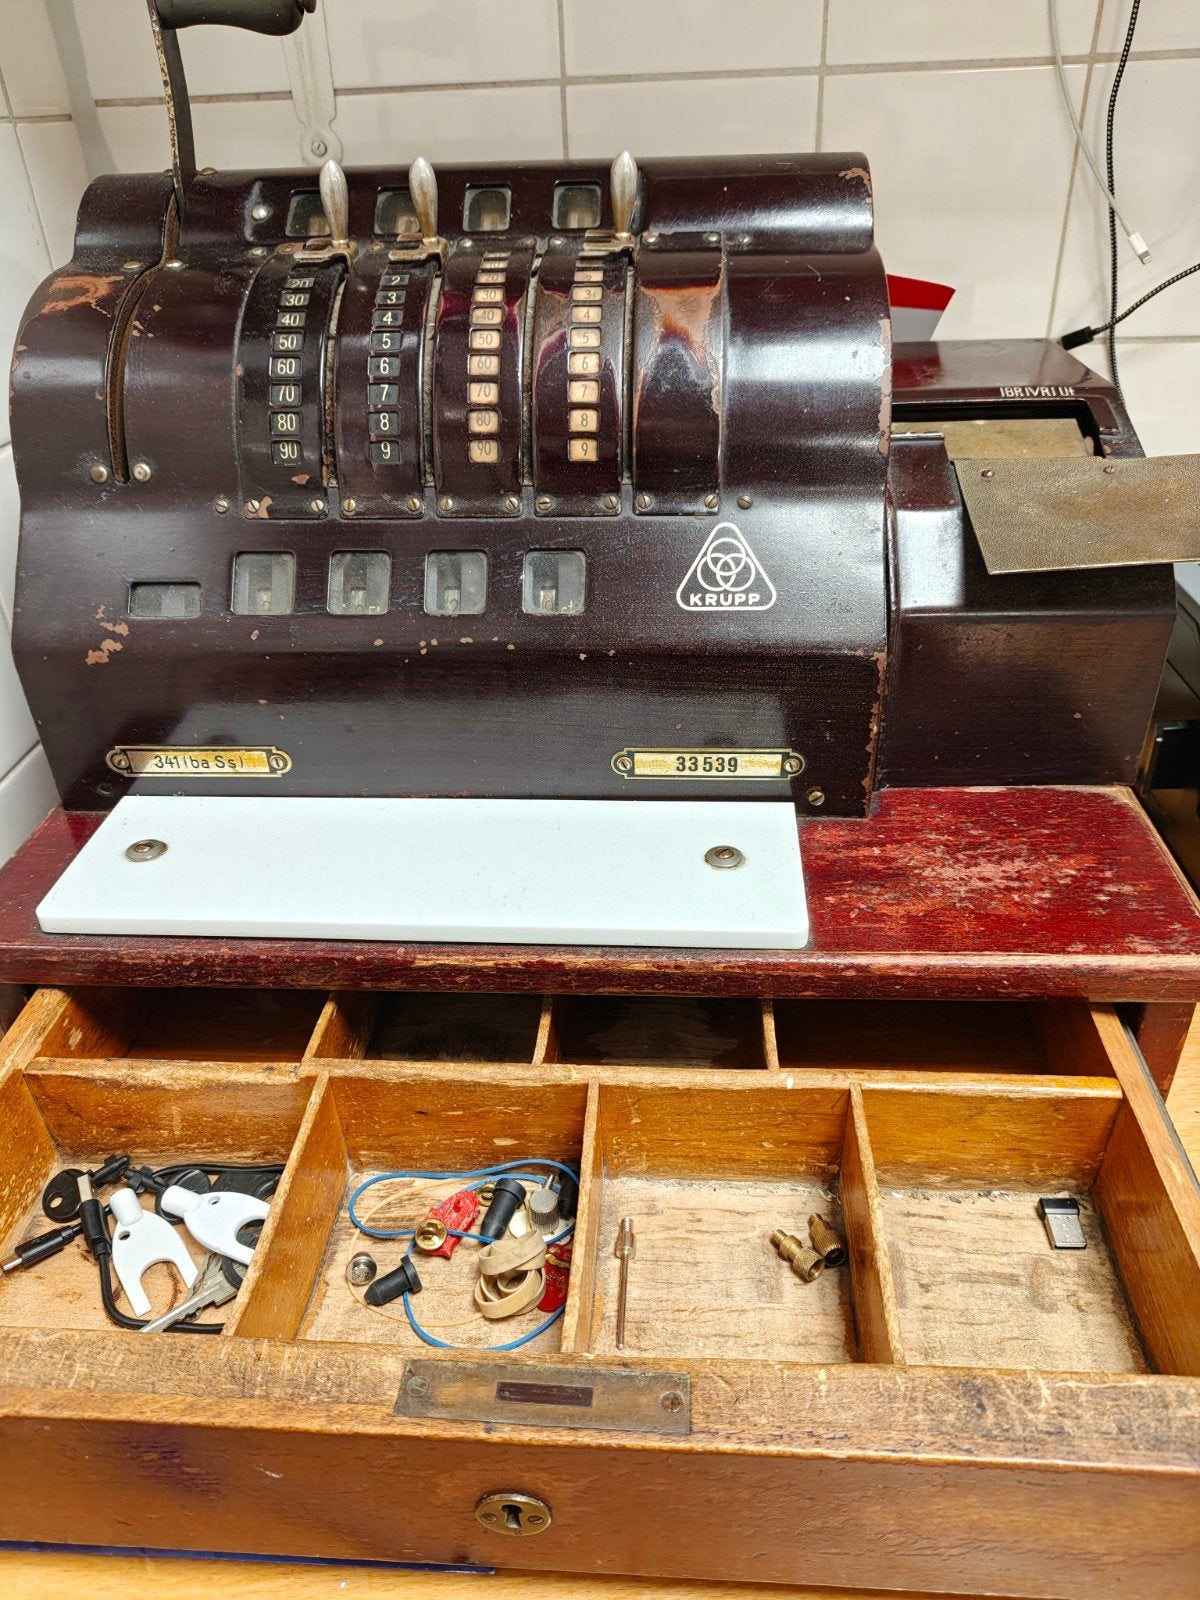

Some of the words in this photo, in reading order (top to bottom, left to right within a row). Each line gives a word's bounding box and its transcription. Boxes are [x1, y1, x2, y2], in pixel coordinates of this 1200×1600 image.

[391, 277, 401, 286] 2
[485, 274, 498, 282] 20
[285, 293, 304, 306] 30
[387, 291, 397, 303] 3
[482, 290, 496, 300] 30
[281, 314, 299, 326] 40
[383, 312, 393, 324] 4
[480, 310, 495, 320] 40
[583, 309, 590, 320] 4
[279, 335, 297, 349] 50
[382, 333, 391, 348] 5
[478, 333, 493, 346] 50
[582, 332, 589, 344] 5
[277, 358, 296, 374] 60
[380, 358, 389, 374] 6
[477, 355, 491, 370] 60
[581, 355, 589, 370] 6
[279, 384, 295, 401] 70
[380, 384, 389, 401] 7
[476, 384, 491, 398] 70
[581, 384, 588, 399] 7
[277, 414, 296, 431] 80
[380, 413, 389, 430] 8
[476, 412, 491, 426] 80
[581, 413, 588, 427] 8
[280, 442, 297, 459] 90
[381, 441, 391, 459] 9
[477, 442, 491, 456] 90
[581, 442, 588, 456] 9
[689, 593, 760, 606] KRUPP
[676, 756, 738, 773] 33539
